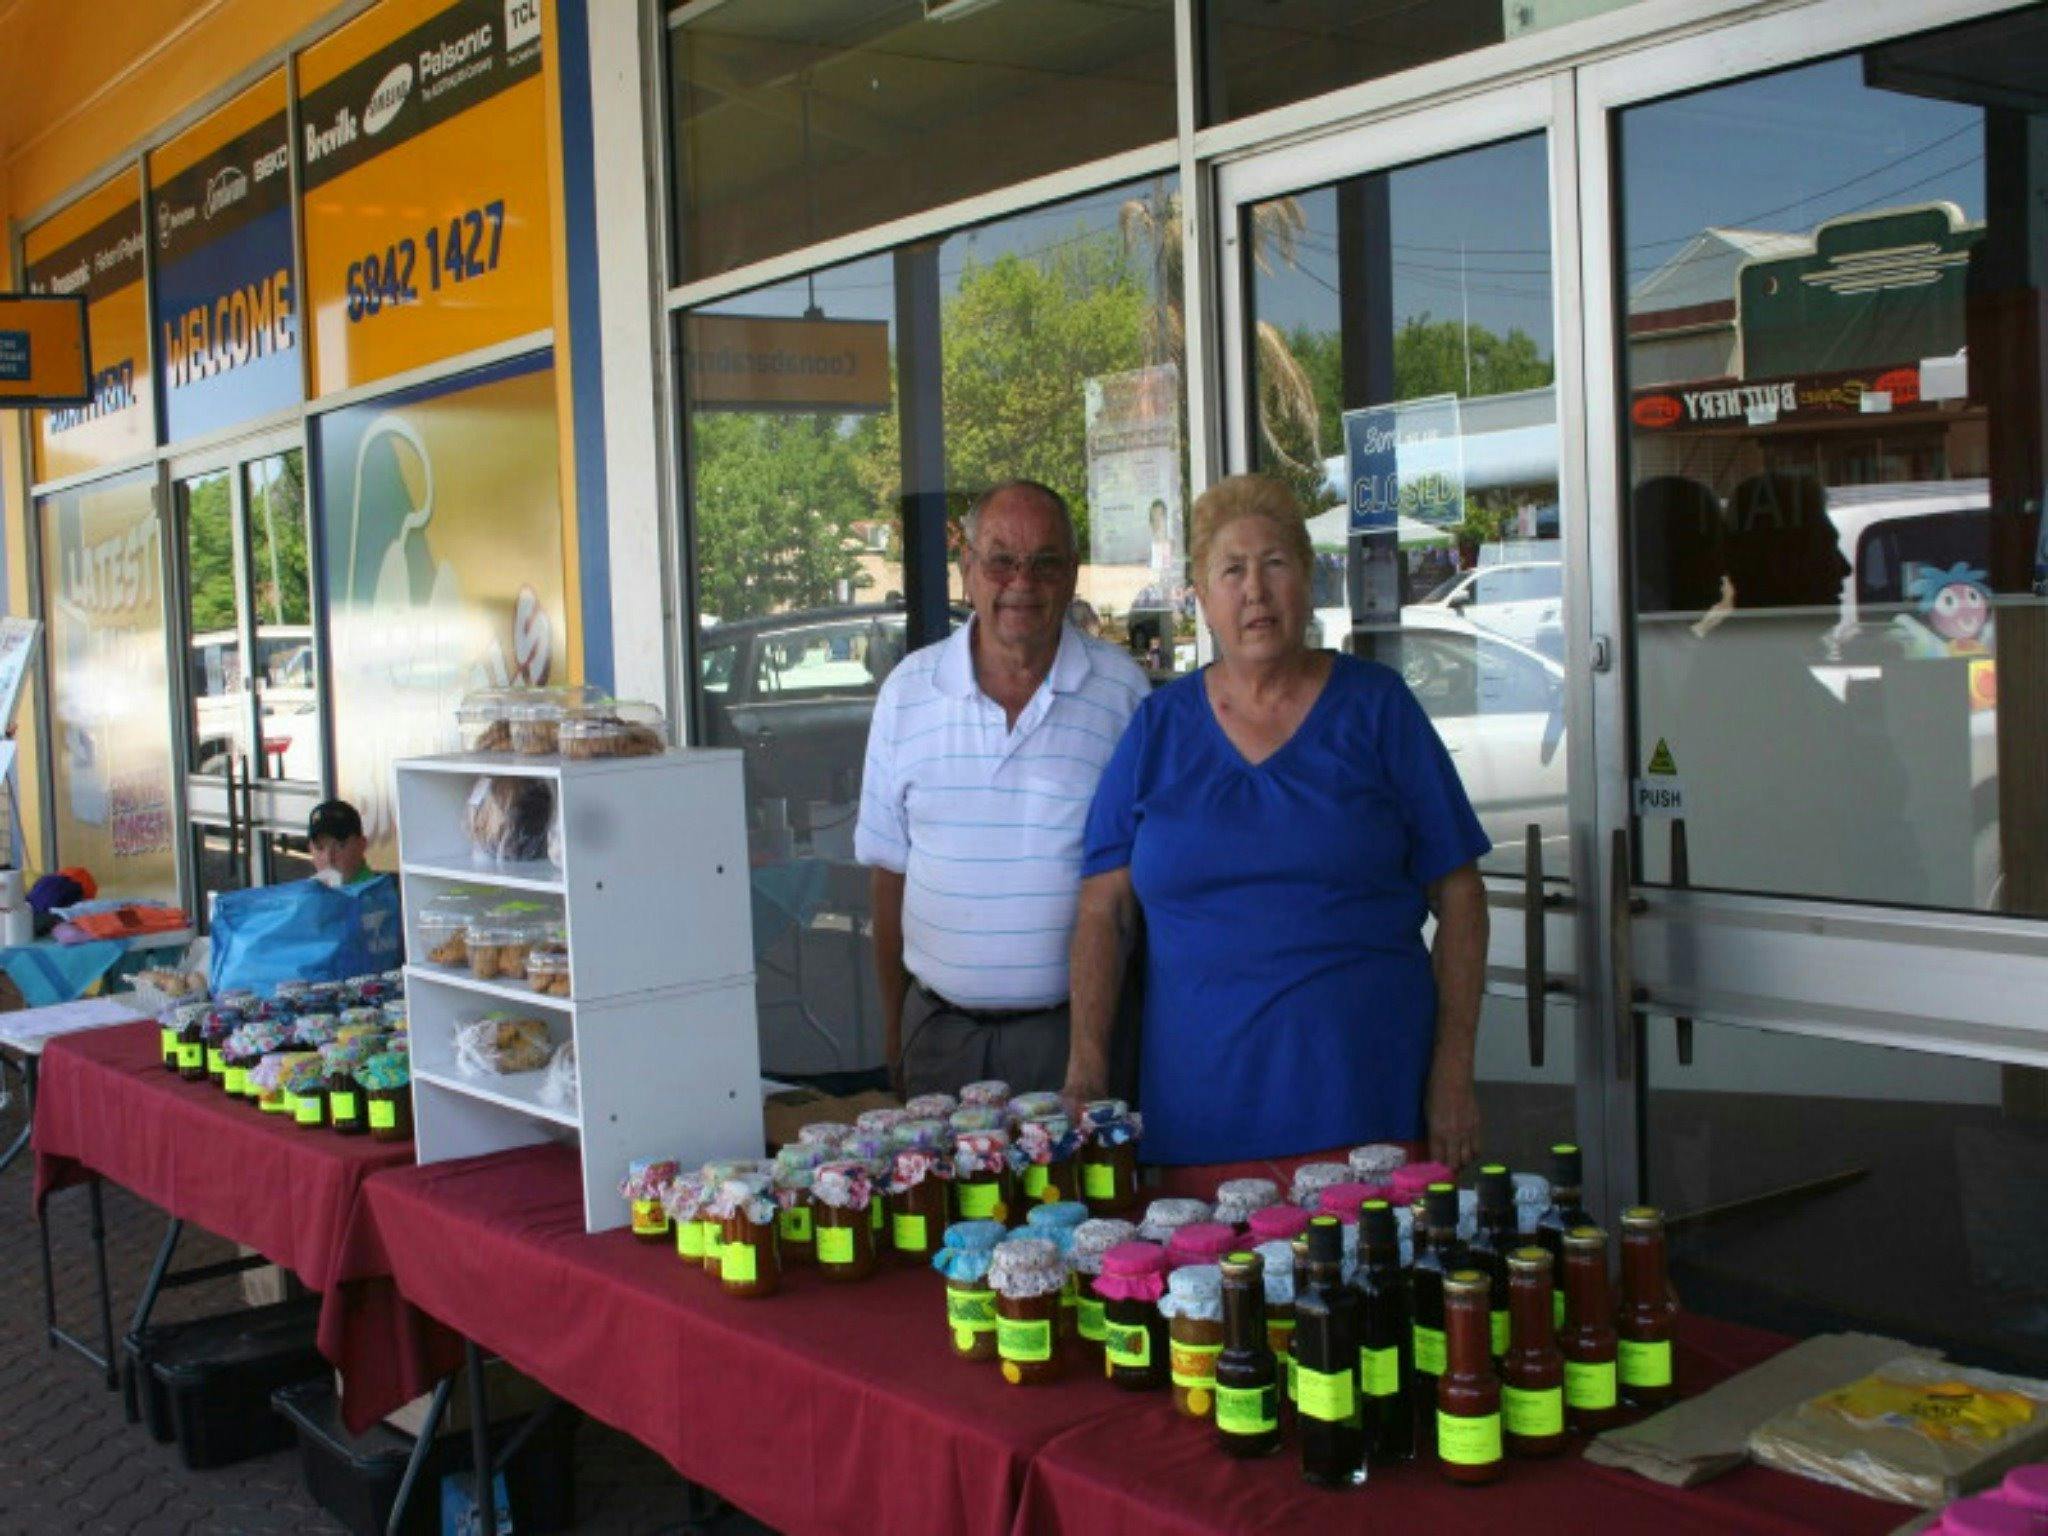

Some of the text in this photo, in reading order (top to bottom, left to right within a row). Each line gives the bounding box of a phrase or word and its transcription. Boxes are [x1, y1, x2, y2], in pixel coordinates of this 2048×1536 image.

[511, 0, 537, 29] TCL
[419, 23, 492, 83] Palsonic
[347, 199, 504, 323] 6842 1427
[163, 268, 295, 389] WELCOME
[1354, 472, 1459, 516] CLOSED
[67, 513, 158, 610] LATEST
[1639, 788, 1682, 809] PUSH
